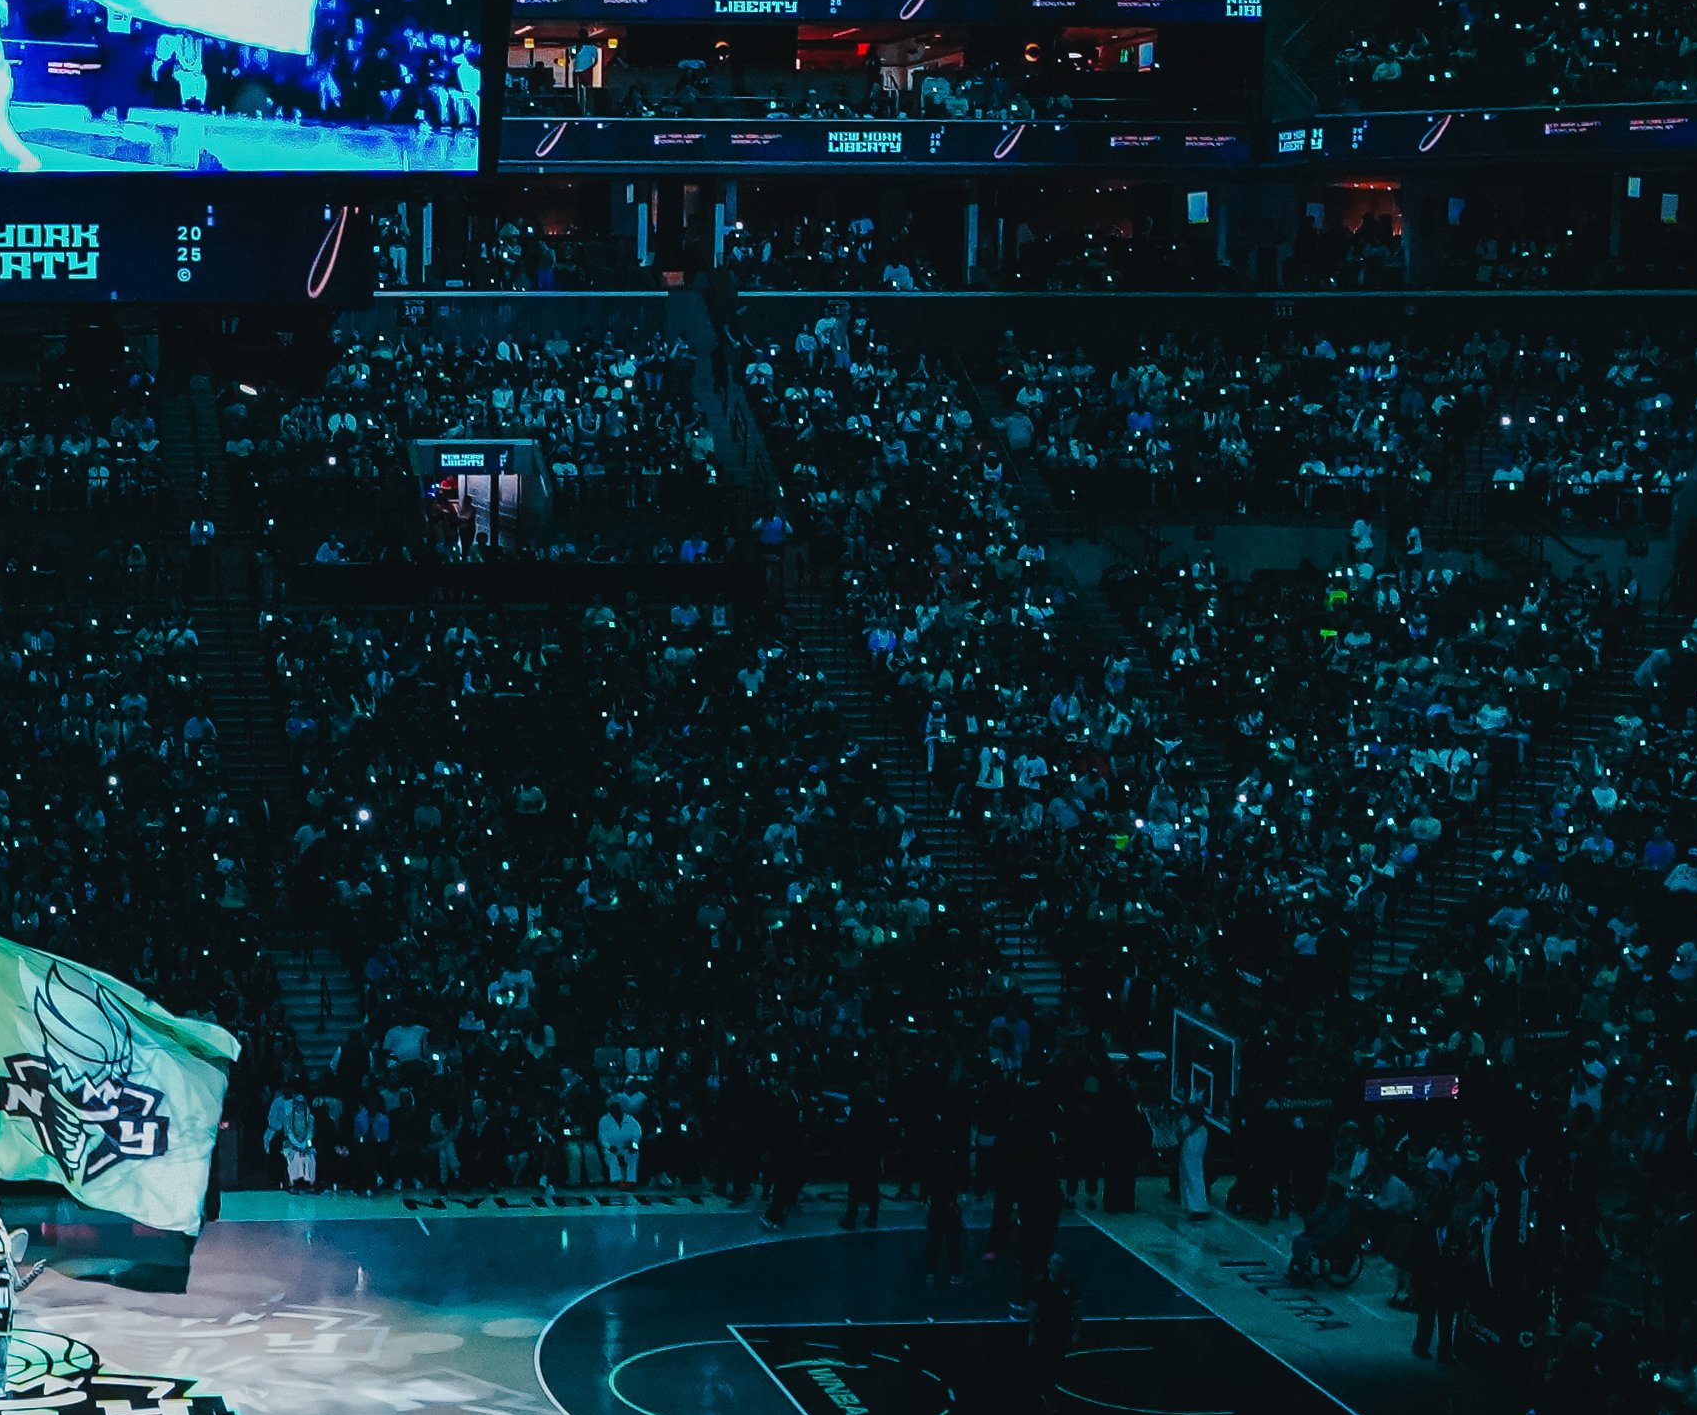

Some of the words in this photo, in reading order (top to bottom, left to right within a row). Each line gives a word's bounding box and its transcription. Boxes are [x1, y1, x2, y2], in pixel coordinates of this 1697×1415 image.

[715, 0, 798, 14] LIBERTY
[828, 132, 860, 141] NEW
[862, 132, 902, 142] YORK
[828, 142, 902, 154] LIBERTY
[177, 226, 202, 241] 20
[177, 247, 202, 262] 25
